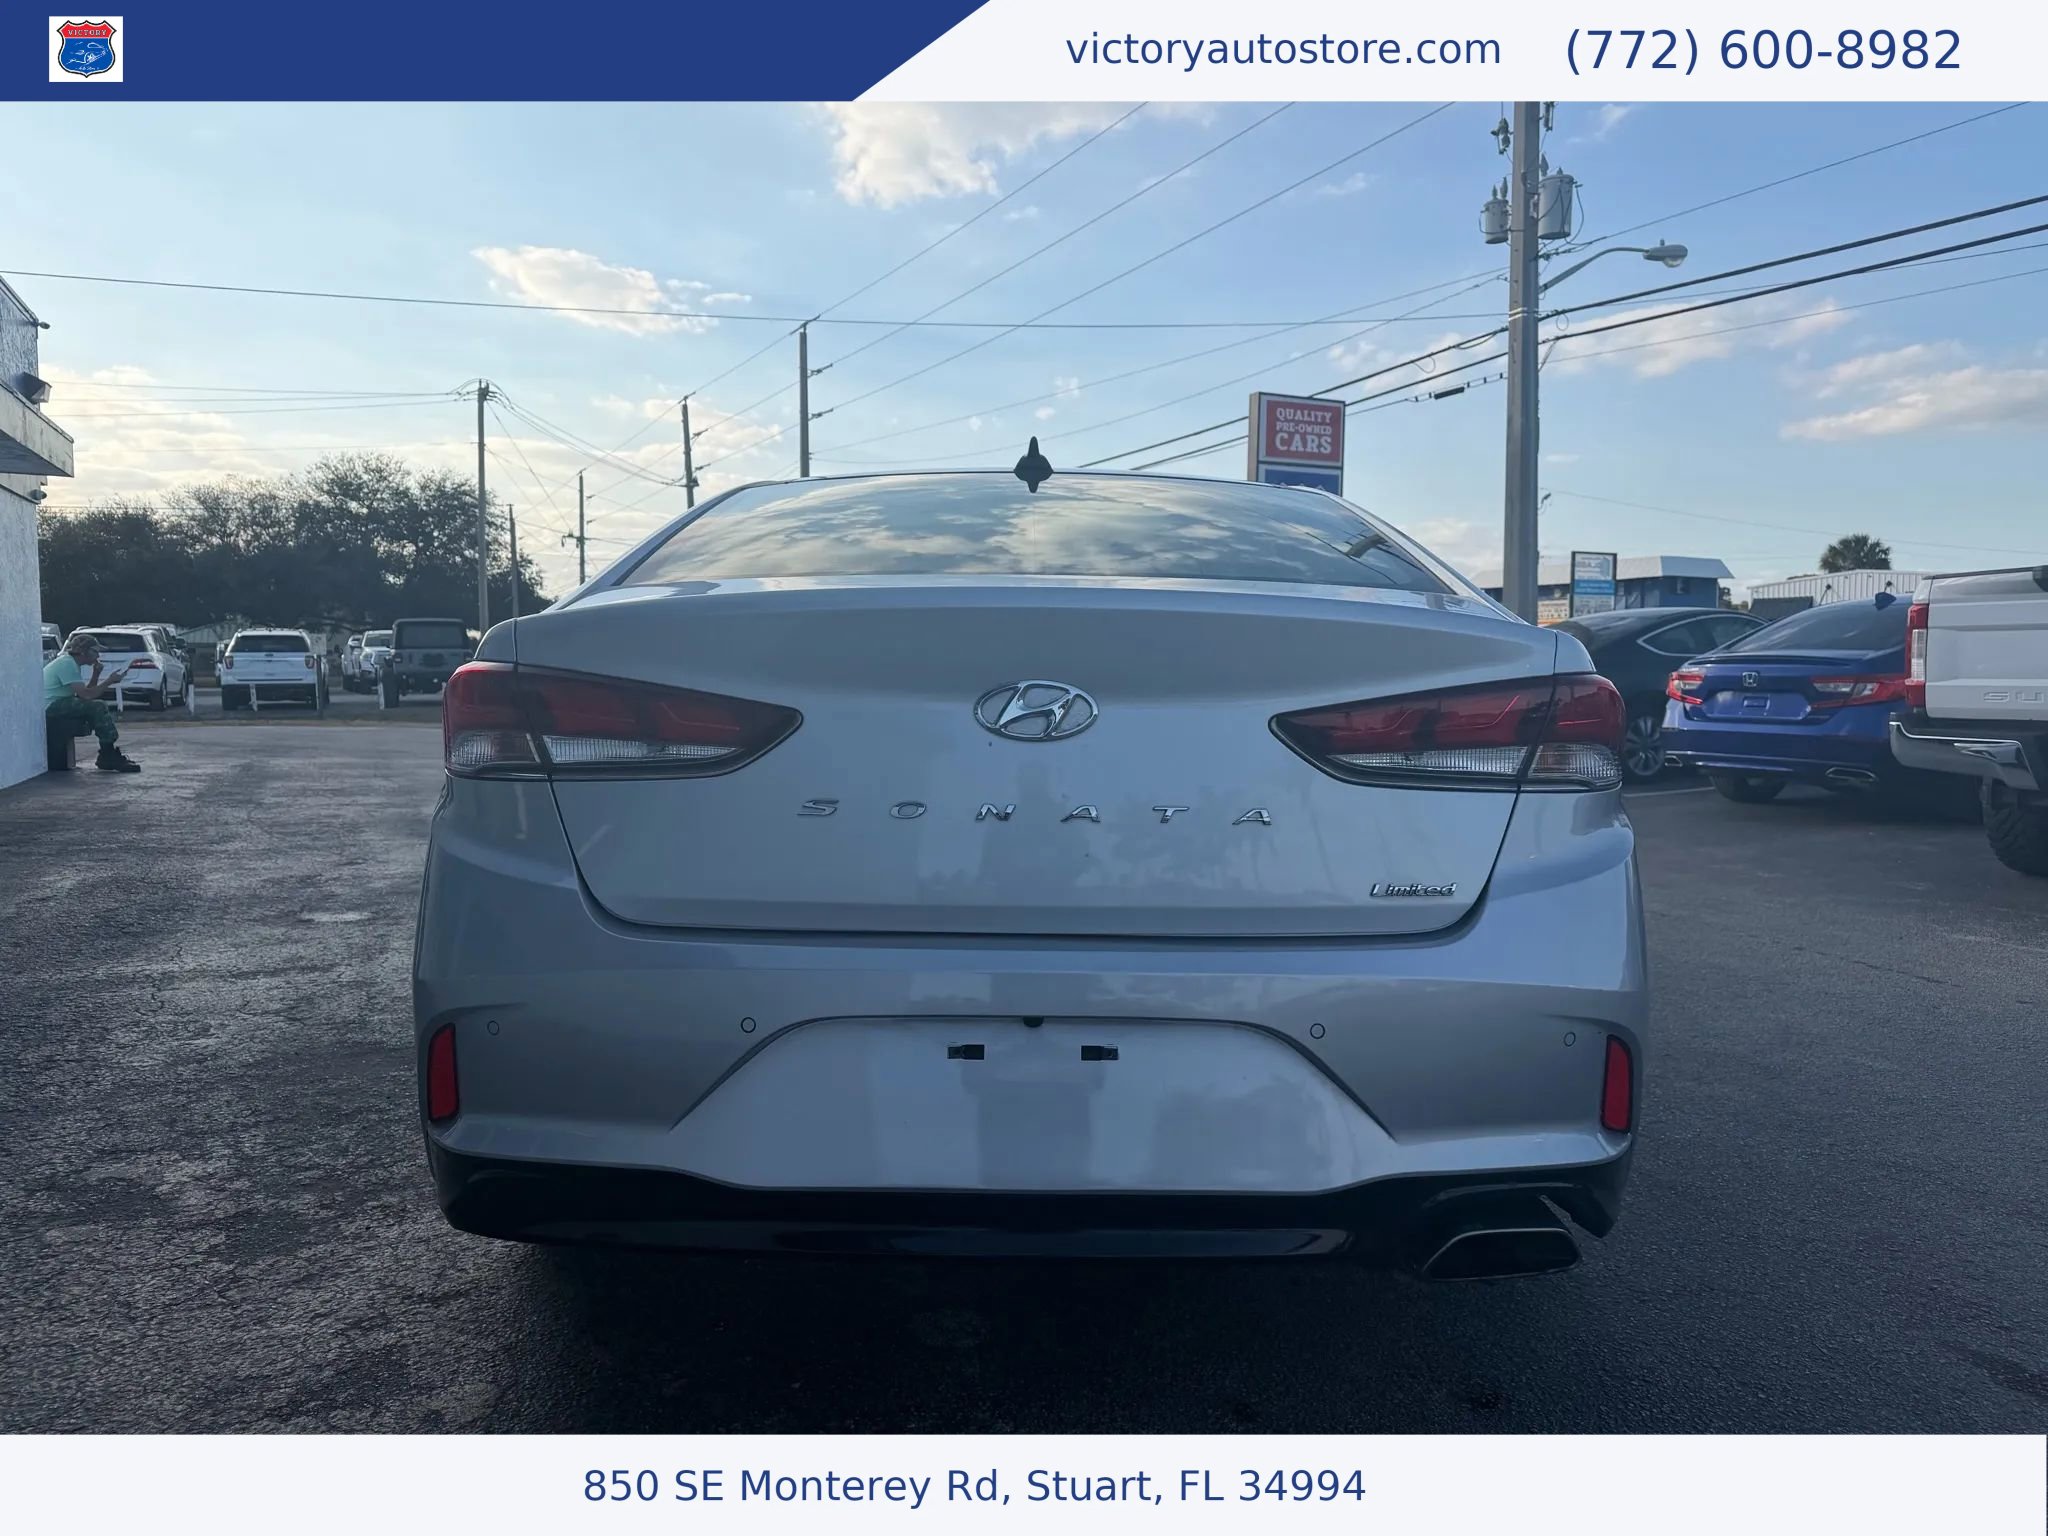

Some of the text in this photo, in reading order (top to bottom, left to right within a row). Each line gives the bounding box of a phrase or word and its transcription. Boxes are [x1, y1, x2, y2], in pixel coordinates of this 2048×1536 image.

[1276, 407, 1332, 423] QUALITY
[1275, 421, 1332, 435] PRE-OWNED
[1275, 432, 1332, 454] CARS
[797, 799, 1272, 825] SONATA
[1369, 882, 1457, 897] Limited
